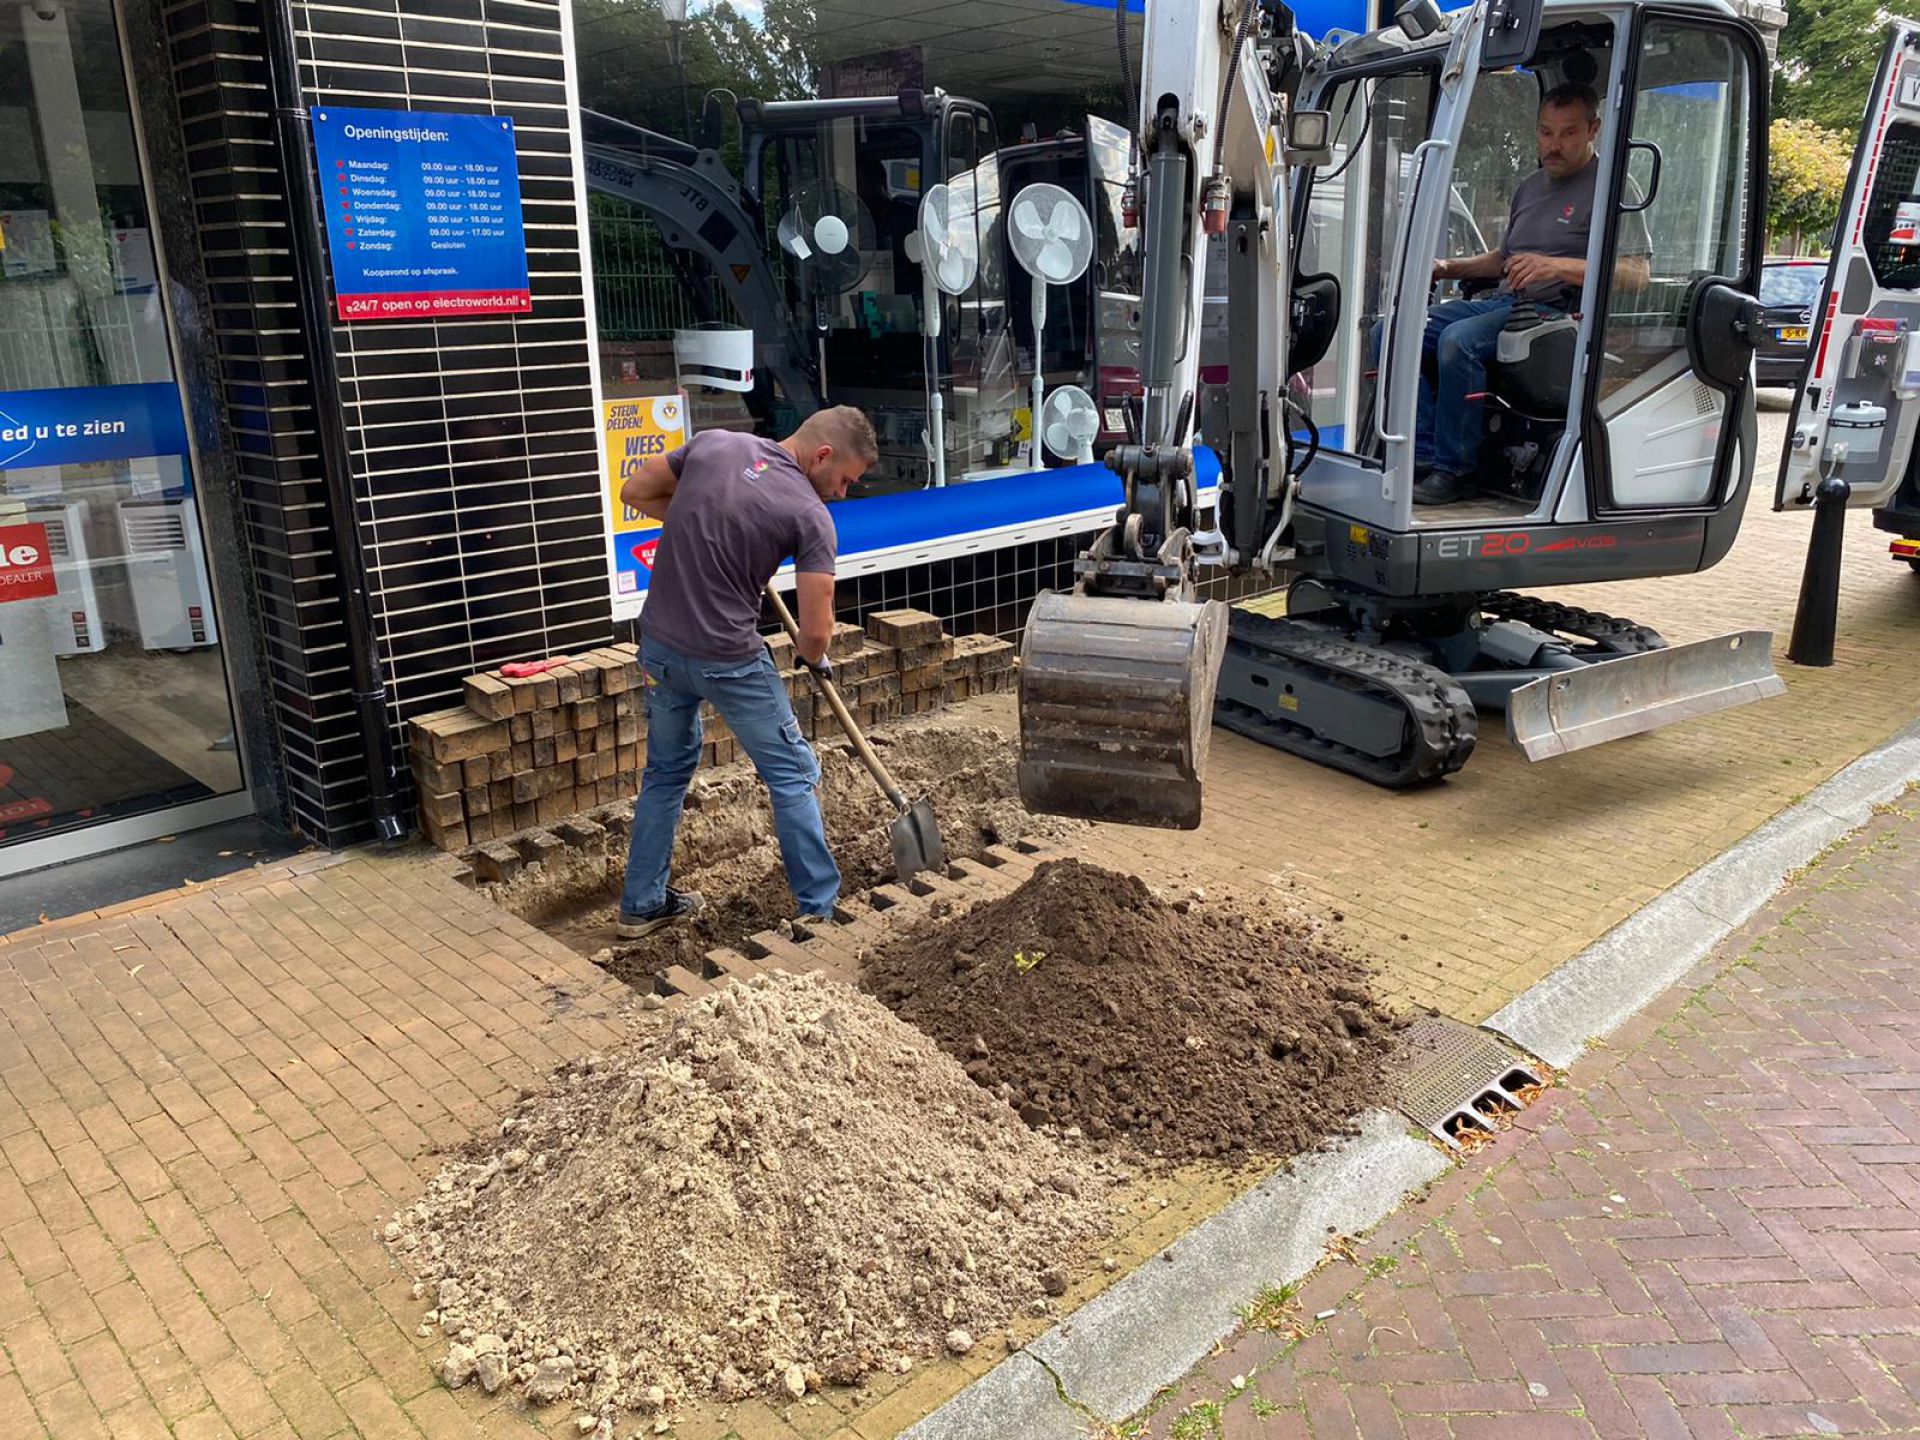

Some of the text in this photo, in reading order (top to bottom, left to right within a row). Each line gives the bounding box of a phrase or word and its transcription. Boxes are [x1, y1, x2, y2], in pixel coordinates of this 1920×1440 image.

[344, 124, 449, 143] Openingstijden:
[349, 160, 390, 171] Maandag:
[421, 162, 443, 170] 09.00
[350, 173, 387, 184] Dinsdag:
[423, 175, 444, 184] 09.00
[352, 187, 398, 198] Woensdag:
[424, 189, 446, 197] 09.00
[354, 201, 402, 211] Donderdag:
[426, 202, 447, 210] 09.00
[355, 215, 387, 224] Vrijdag:
[427, 215, 449, 223] 09.00
[358, 228, 398, 238] Zaterdag:
[429, 228, 451, 236] 09.00
[360, 241, 466, 251] Zondag: Gesloten
[363, 267, 459, 278] Koopavond op afspraak.
[352, 295, 519, 312] 24/7 open op electroworld.nl!
[610, 403, 639, 418] STEUN
[606, 415, 644, 431] DELDEN!
[36, 426, 49, 439] u
[55, 423, 78, 437] te
[83, 420, 126, 436] zien
[625, 434, 666, 456] WEES
[1438, 533, 1531, 558] ET20
